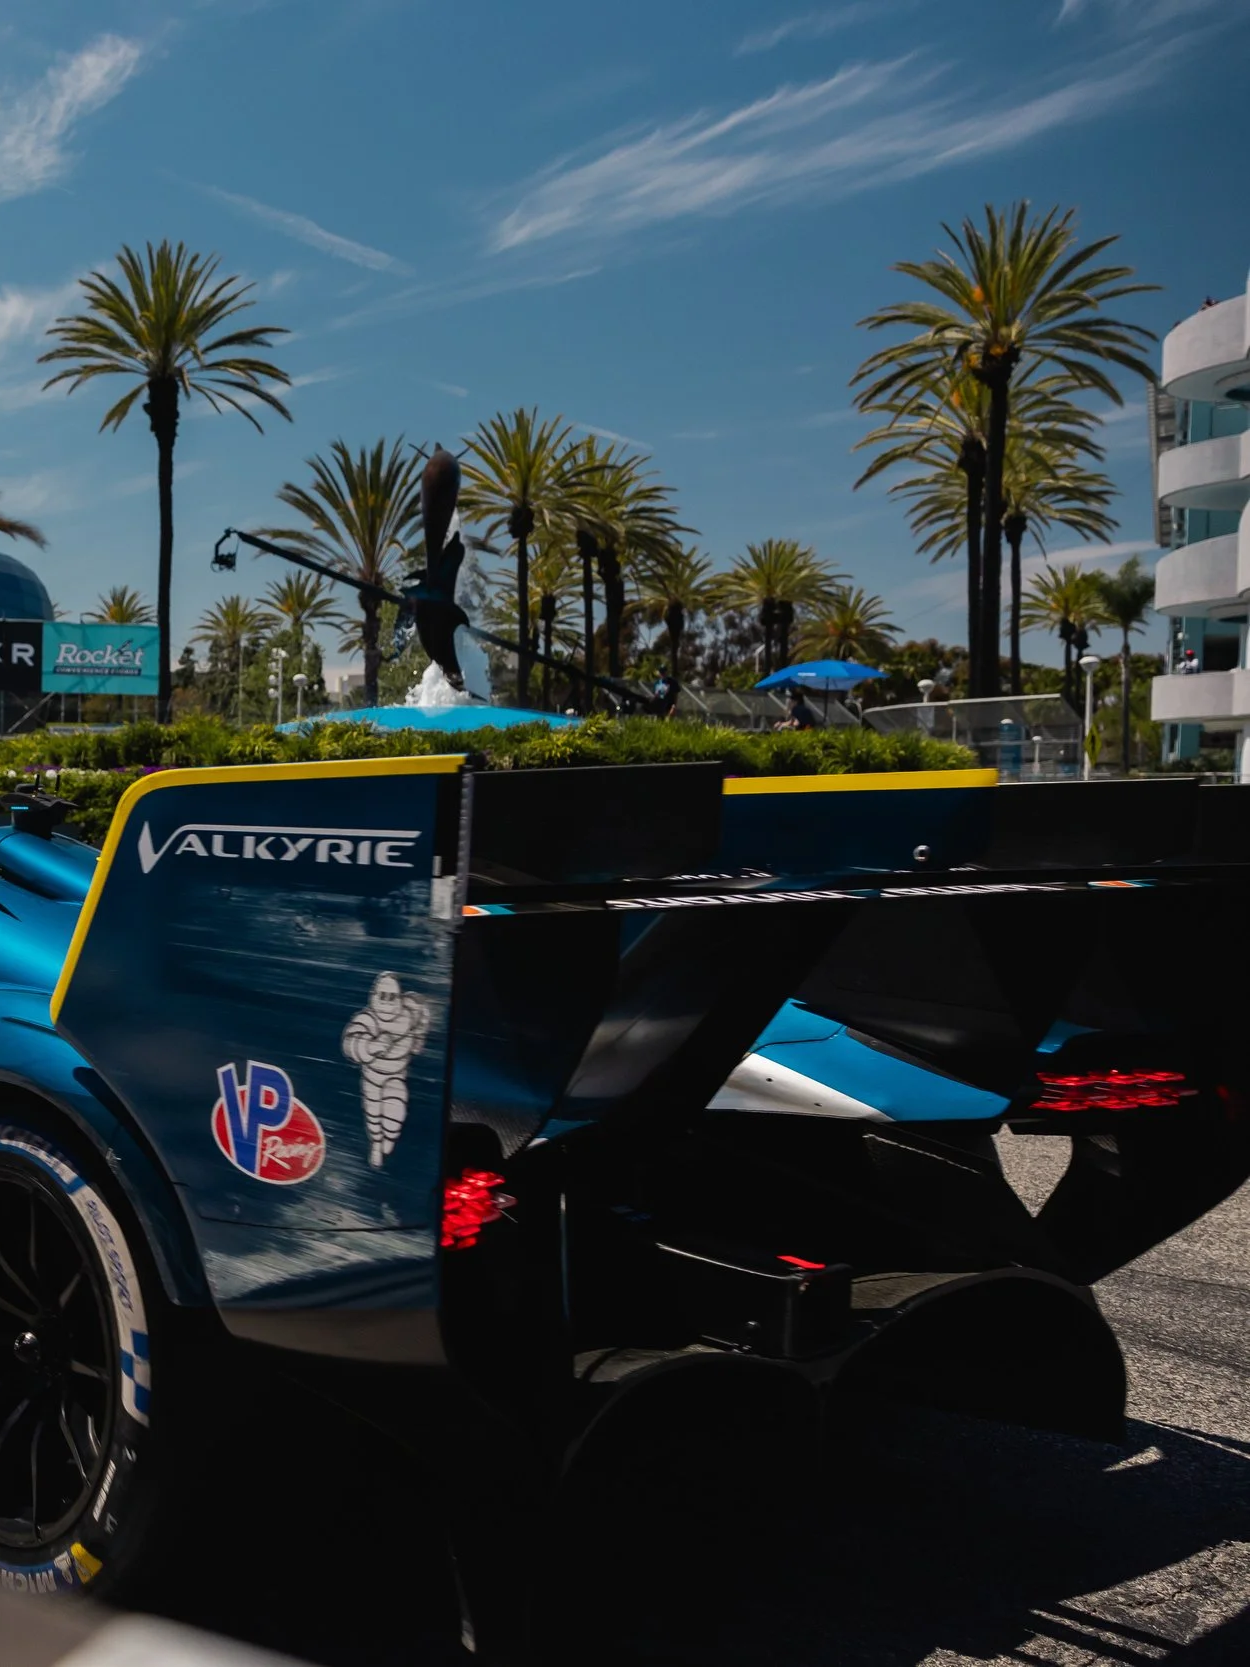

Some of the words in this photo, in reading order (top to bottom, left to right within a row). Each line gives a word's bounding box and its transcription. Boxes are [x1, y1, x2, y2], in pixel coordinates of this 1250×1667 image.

[55, 640, 144, 666] Rocket
[138, 822, 421, 874] VALKYRIE
[217, 1060, 294, 1177] VP
[261, 1134, 321, 1169] Racing
